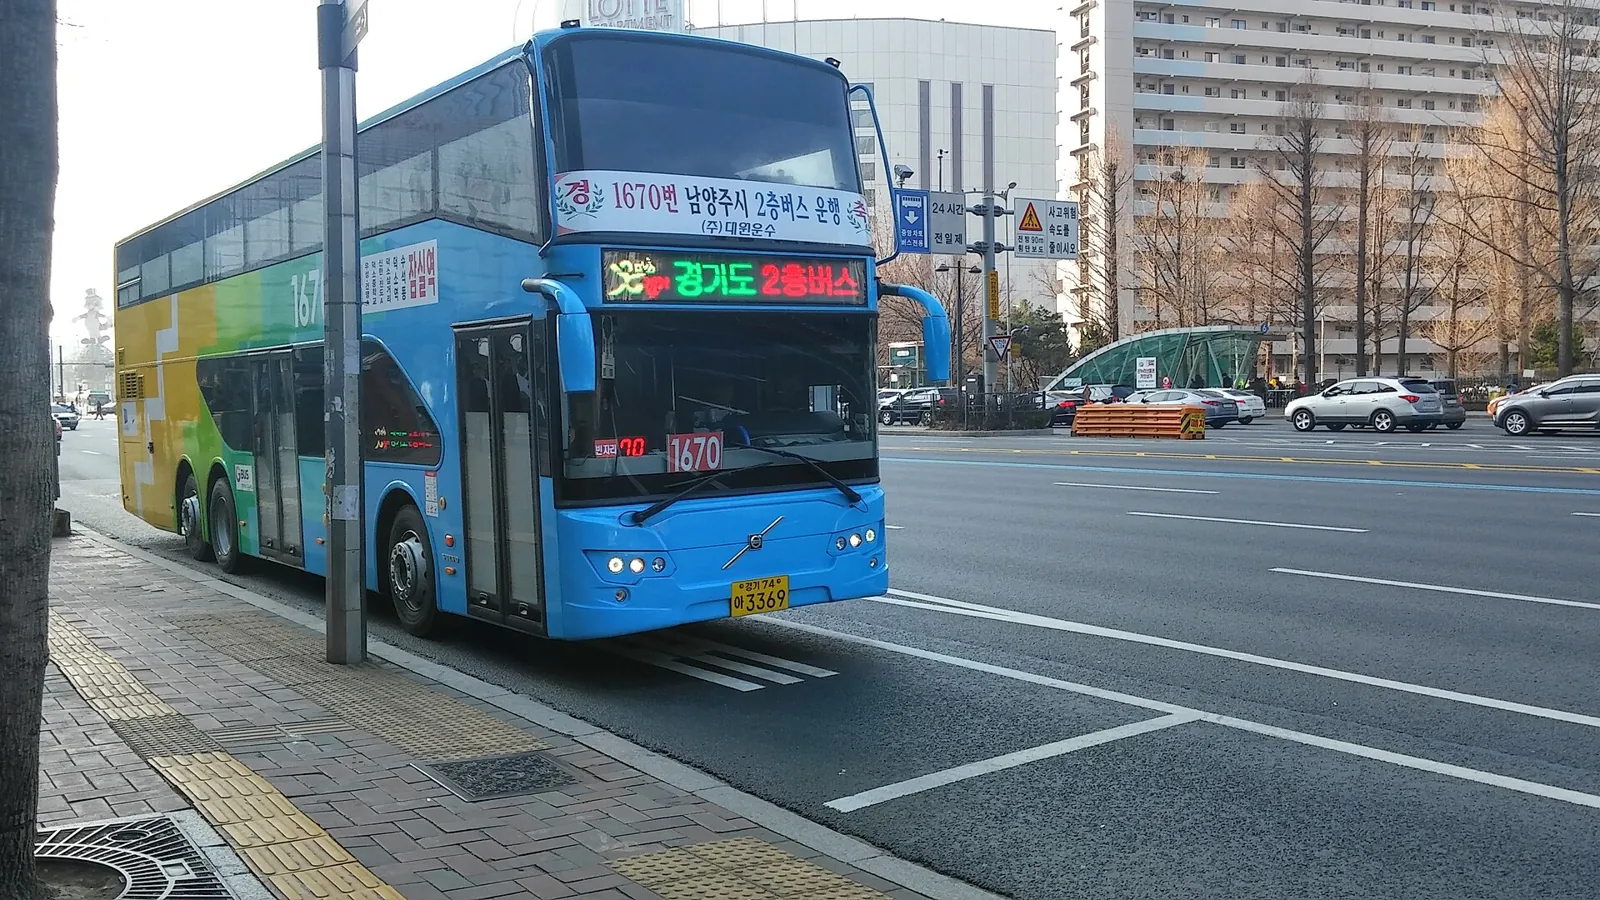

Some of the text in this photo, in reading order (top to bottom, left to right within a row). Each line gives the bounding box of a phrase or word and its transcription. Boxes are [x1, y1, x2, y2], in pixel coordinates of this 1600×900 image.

[564, 179, 590, 205] 경
[612, 182, 841, 226] 1670번 남양주시 2층버스 운행
[854, 200, 868, 224] 축
[1048, 206, 1077, 220] 사고위험
[934, 232, 964, 245] 전일제
[1048, 224, 1070, 237] 속도를
[1049, 241, 1077, 254] 줄이시오
[408, 246, 436, 299] 잠실역
[673, 260, 758, 298] 경기도
[761, 263, 859, 299] 2층버스
[291, 268, 325, 328] 167
[595, 444, 617, 456] 빈자리
[620, 437, 645, 456] 70
[671, 436, 720, 472] 1670
